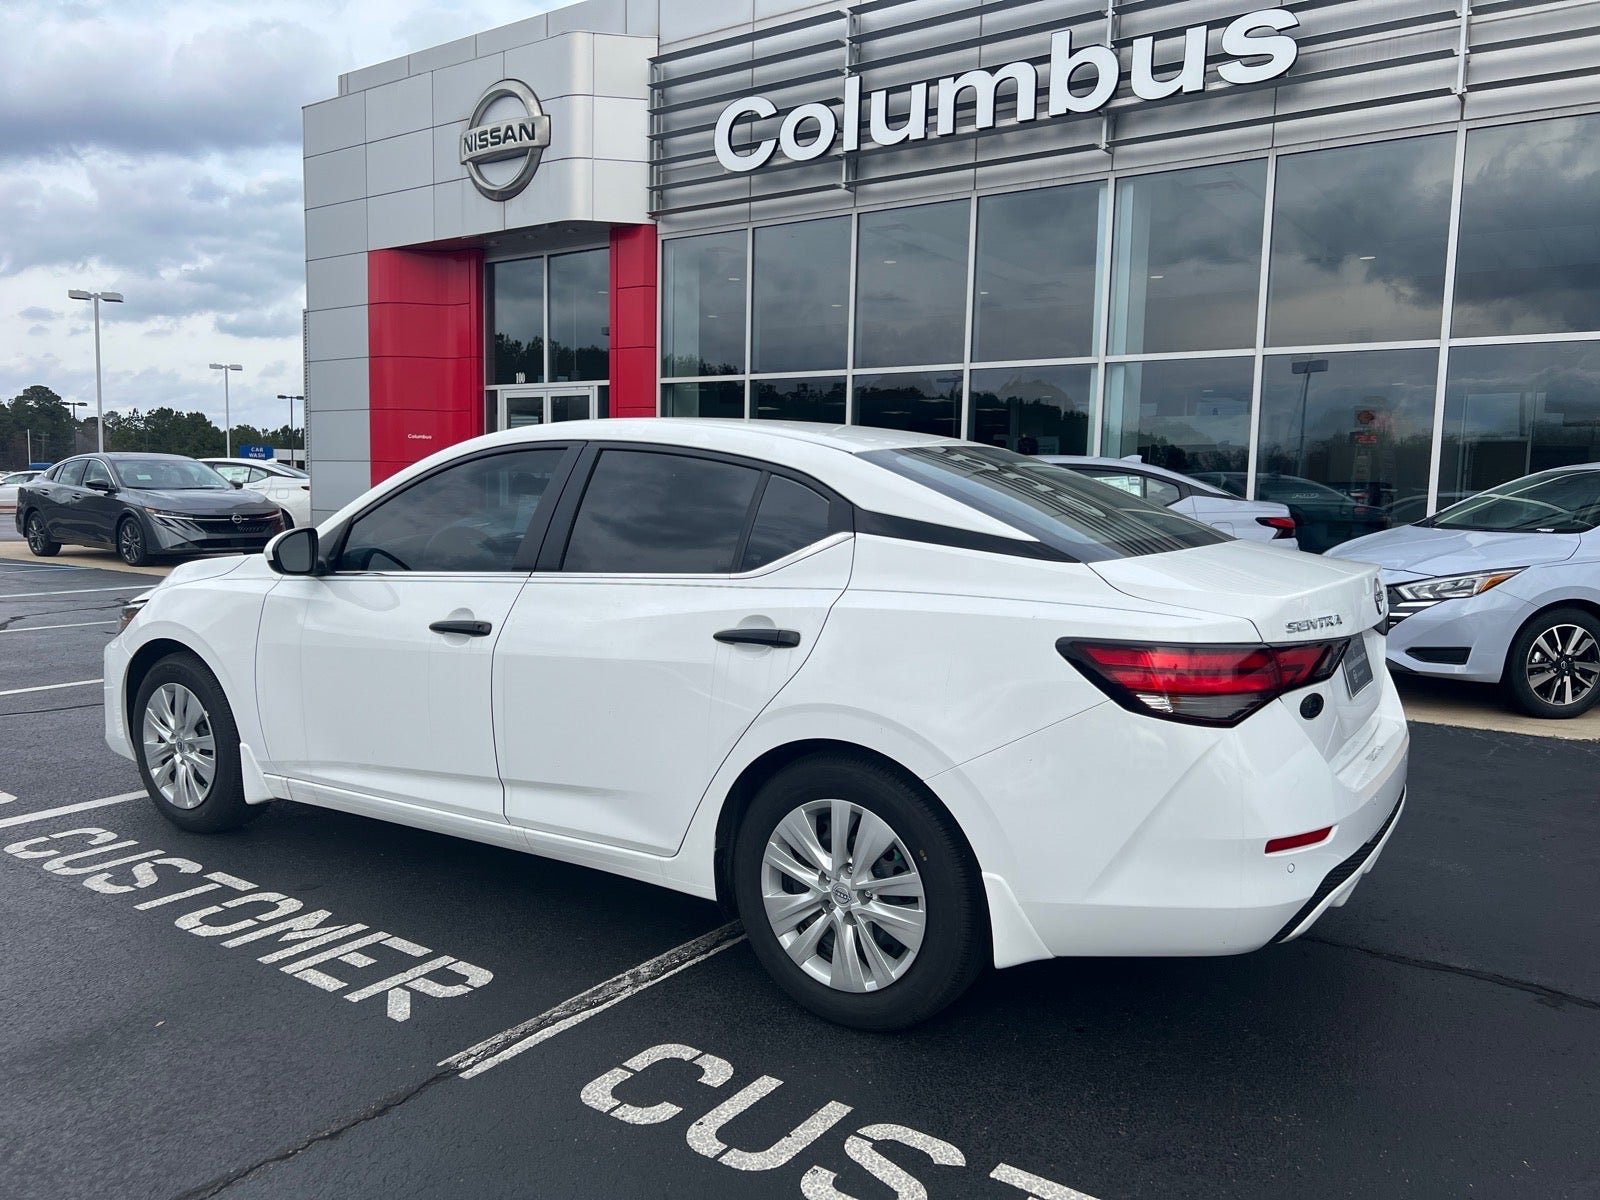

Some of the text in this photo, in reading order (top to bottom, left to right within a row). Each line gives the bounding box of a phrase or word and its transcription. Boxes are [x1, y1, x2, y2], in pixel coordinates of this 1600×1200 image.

[713, 8, 1300, 173] Columbus
[463, 121, 536, 155] NISSAN
[515, 372, 526, 384] 100
[1285, 614, 1343, 634] SENTRA
[3, 826, 494, 1023] CUSTOMER
